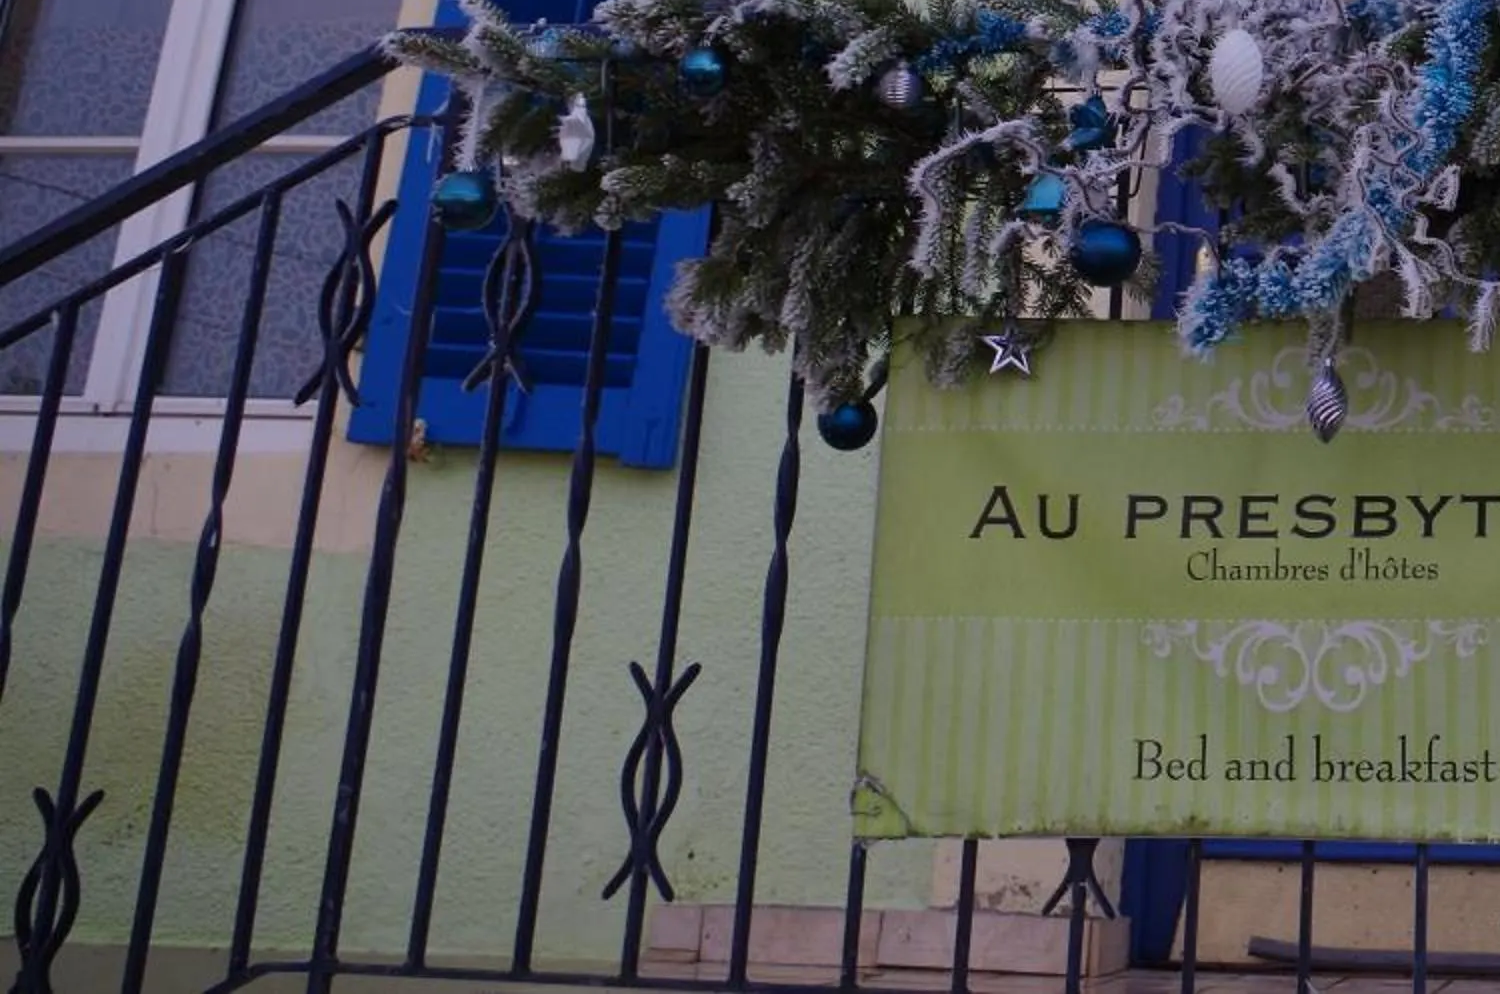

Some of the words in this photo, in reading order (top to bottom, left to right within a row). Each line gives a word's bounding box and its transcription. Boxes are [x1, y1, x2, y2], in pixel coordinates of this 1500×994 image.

[969, 485, 1080, 540] AU
[1186, 547, 1329, 581] Chambres
[1340, 547, 1439, 581] d'hôtes
[1133, 734, 1208, 781] Bed
[1225, 735, 1297, 782] and
[1312, 734, 1497, 783] breakfast
